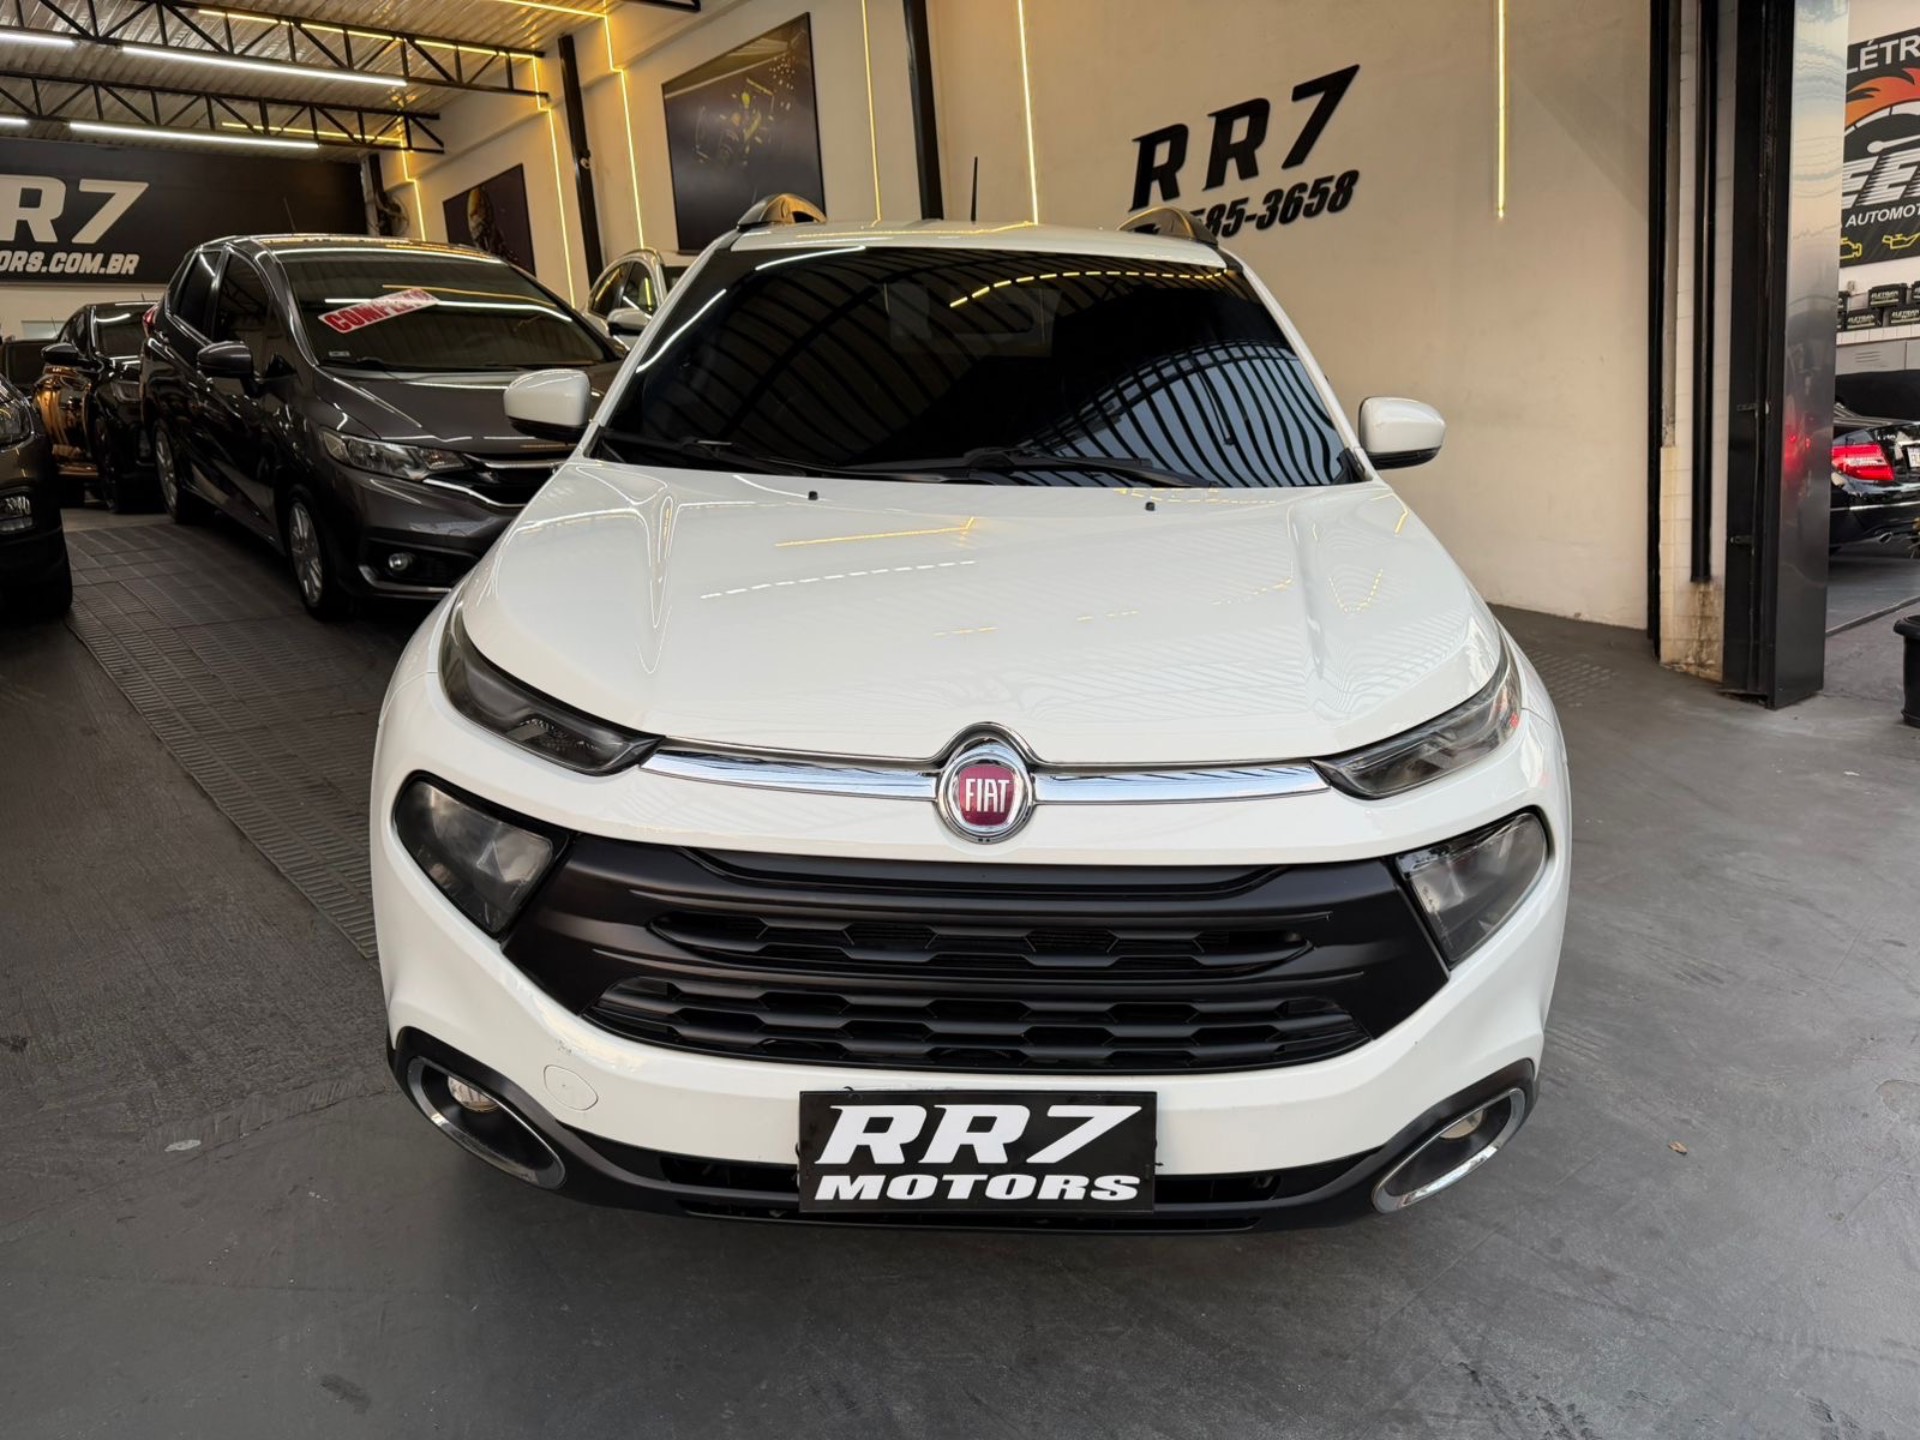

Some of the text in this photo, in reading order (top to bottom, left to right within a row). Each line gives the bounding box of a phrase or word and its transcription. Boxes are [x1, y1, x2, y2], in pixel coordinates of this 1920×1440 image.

[1847, 35, 1920, 74] ÉTR
[1128, 64, 1360, 213] RR7
[1189, 169, 1360, 238] 85-3658
[965, 778, 1010, 813] FIAT
[814, 1104, 1142, 1165] RR7
[814, 1174, 1141, 1201] MOTORS
